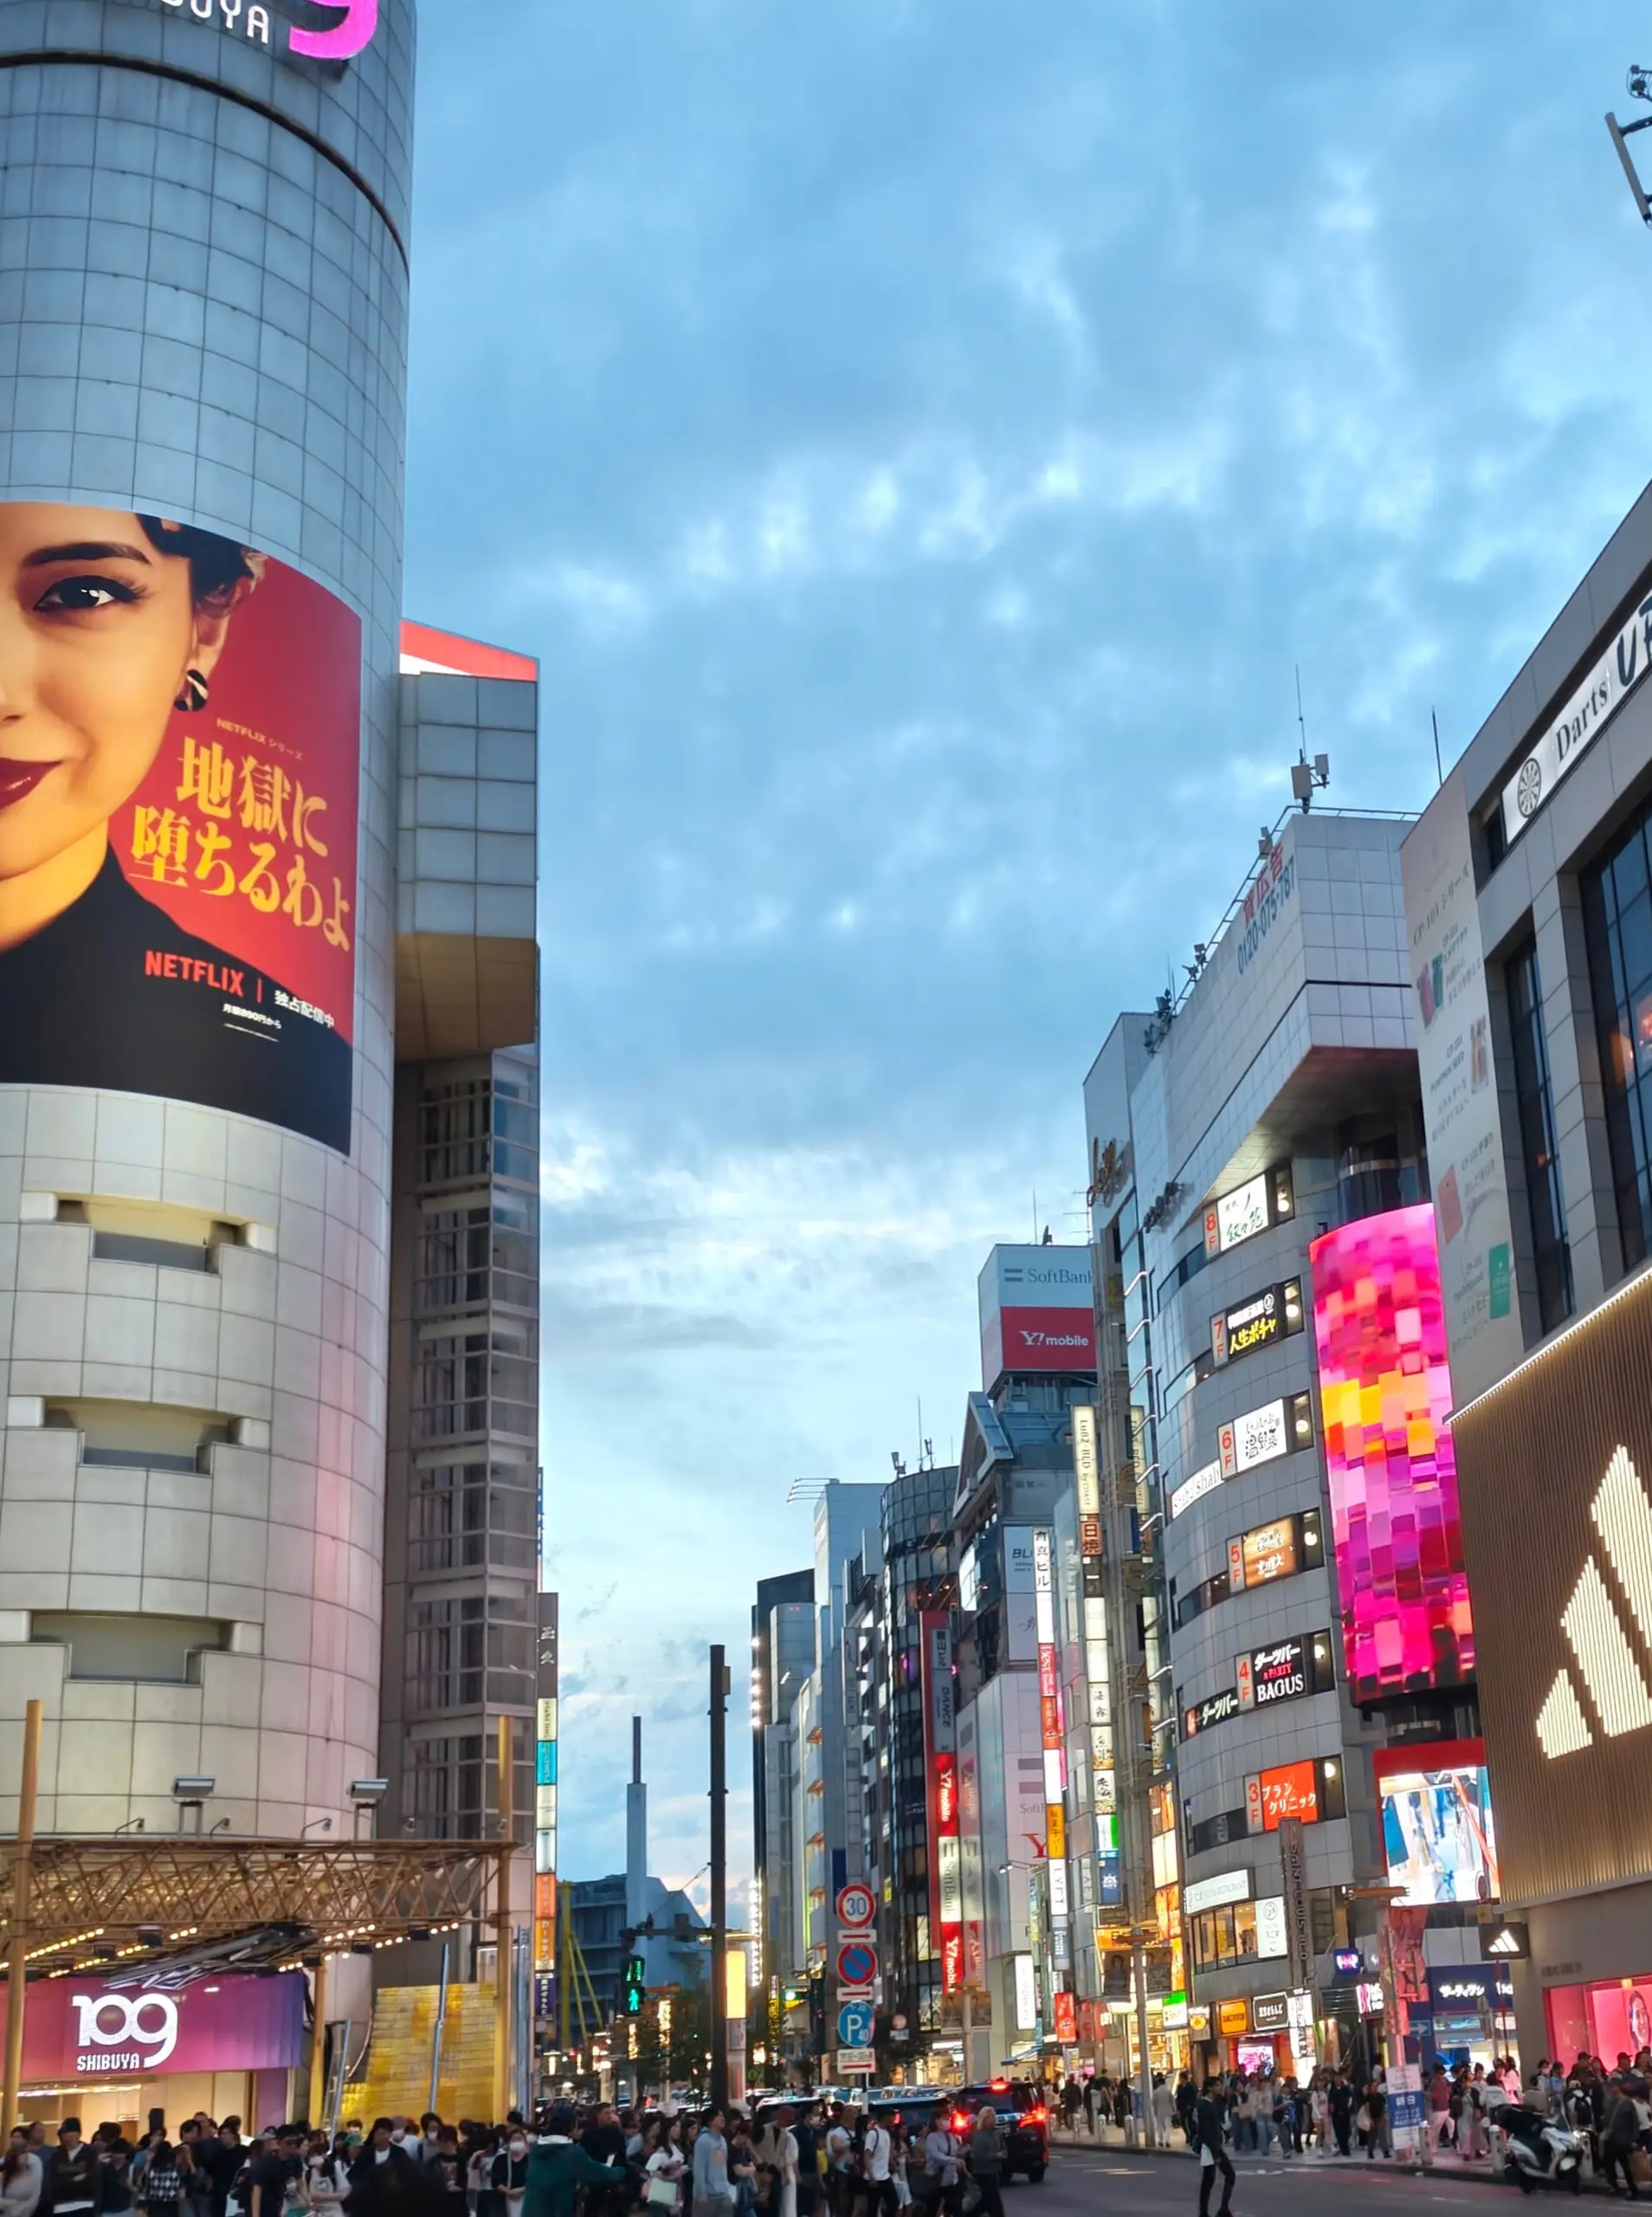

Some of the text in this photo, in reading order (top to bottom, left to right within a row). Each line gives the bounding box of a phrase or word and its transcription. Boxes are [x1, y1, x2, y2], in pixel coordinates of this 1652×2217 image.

[216, 717, 303, 761] NETFLIX シリーズ
[1556, 678, 1609, 764] Darts
[176, 735, 329, 857] 地獄に
[128, 805, 352, 953] 堕ちるわよ
[145, 951, 244, 998] NETFLIX
[1255, 1644, 1301, 1671] ダーツバー
[941, 1685, 952, 1729] DANCE
[1257, 1673, 1304, 1703] BAGUS
[1269, 1790, 1317, 1816] クリニック
[846, 1897, 867, 1916] 30
[72, 1993, 178, 2069] 109
[847, 2014, 863, 2043] P
[77, 2052, 140, 2072] SHIBUYA
